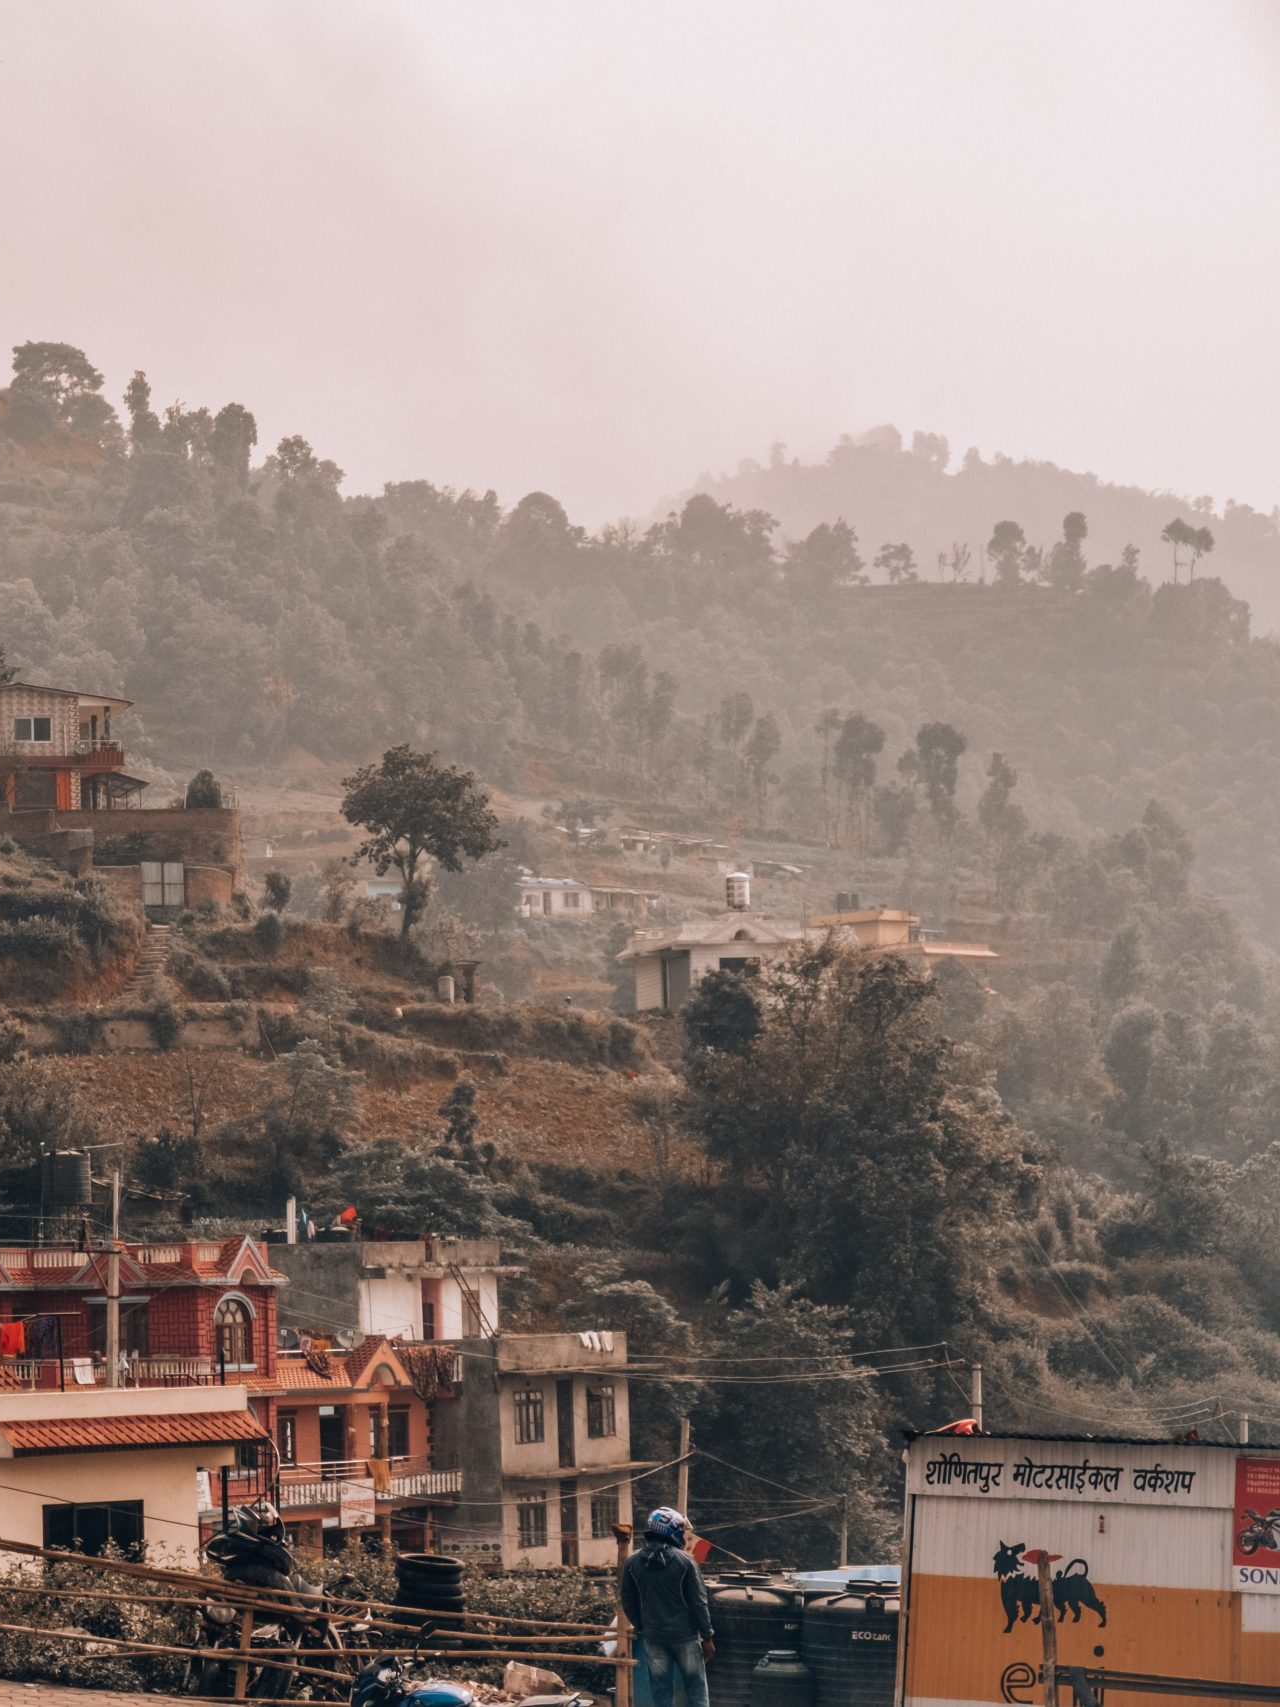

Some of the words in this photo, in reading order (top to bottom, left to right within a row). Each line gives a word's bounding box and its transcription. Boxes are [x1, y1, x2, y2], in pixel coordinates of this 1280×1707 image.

[925, 1452, 1004, 1494] शोणितपुर
[1013, 1456, 1124, 1494] मोटरसाईकल
[1133, 1463, 1196, 1494] वर्कशप
